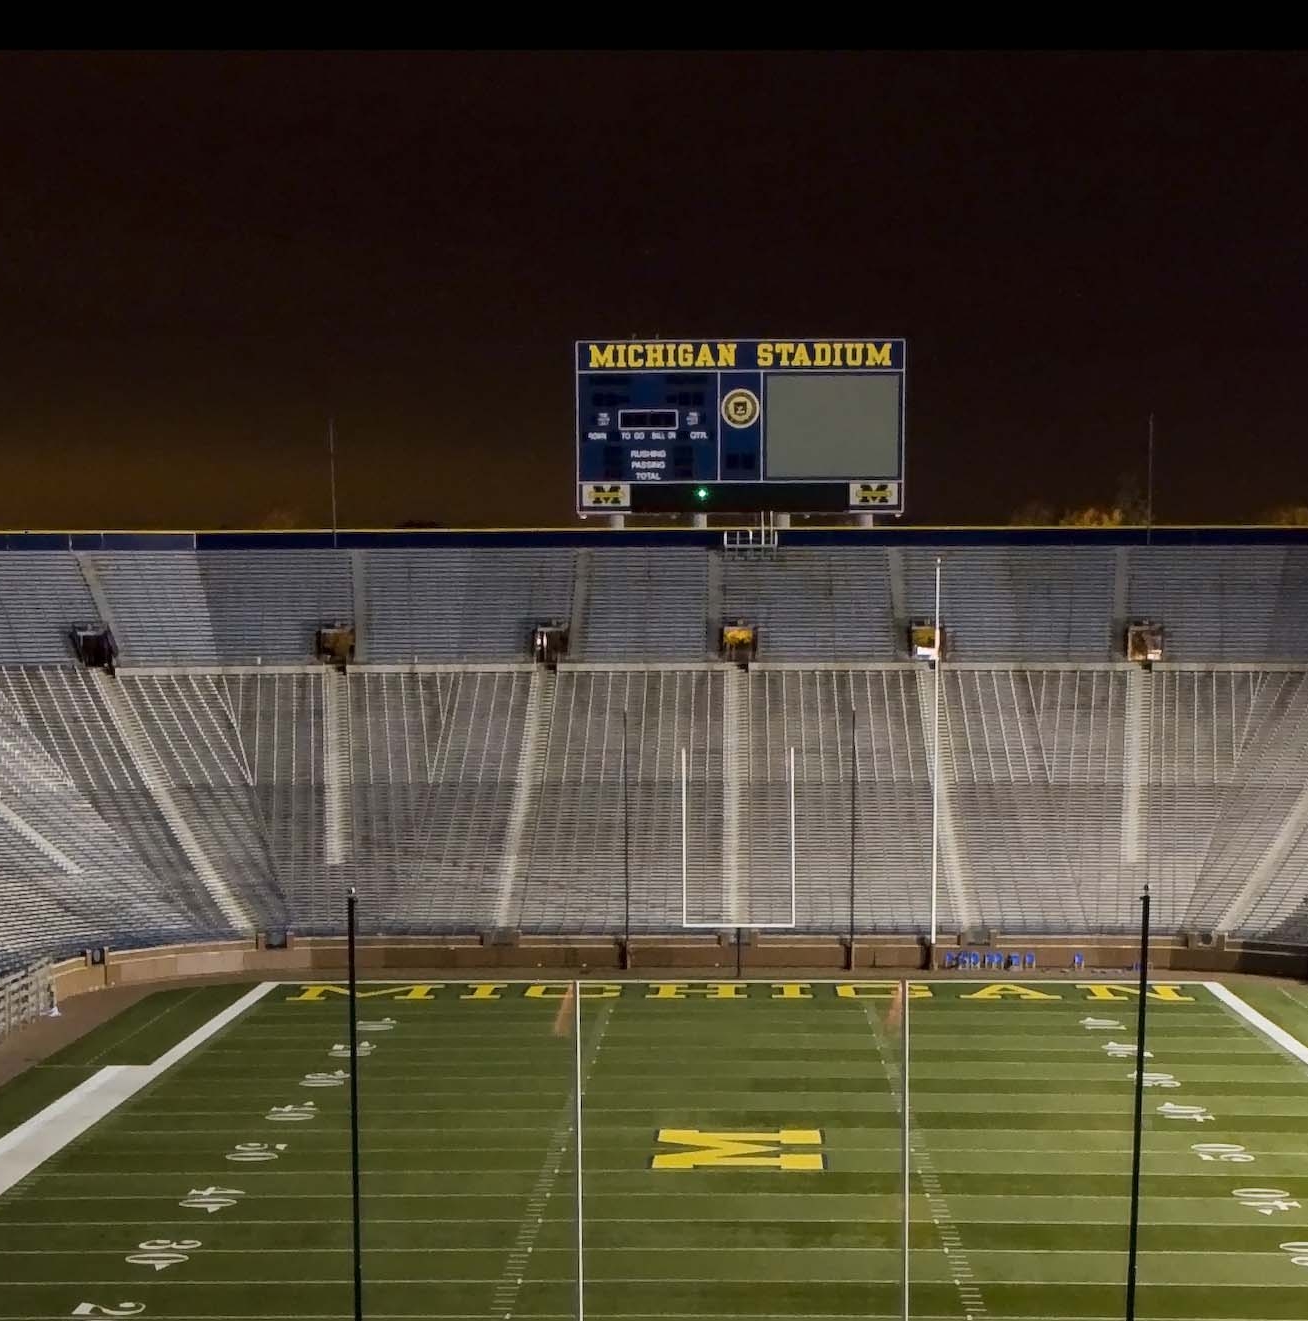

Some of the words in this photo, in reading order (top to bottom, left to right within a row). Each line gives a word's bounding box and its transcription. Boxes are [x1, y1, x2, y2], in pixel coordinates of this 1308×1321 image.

[589, 343, 738, 368] MICHIGAN
[757, 342, 893, 367] STADIUM
[630, 449, 667, 458] RUSHING
[631, 460, 666, 469] PASSING
[635, 472, 662, 481] TOTAL
[285, 983, 1196, 1001] MICHIGAN
[265, 1104, 319, 1121] 40
[1156, 1104, 1216, 1122] 40
[225, 1142, 288, 1162] 50
[650, 1128, 826, 1171] M
[1191, 1142, 1256, 1163] 50
[179, 1186, 247, 1209] 40
[1231, 1187, 1302, 1212] 40
[125, 1239, 203, 1265] 30
